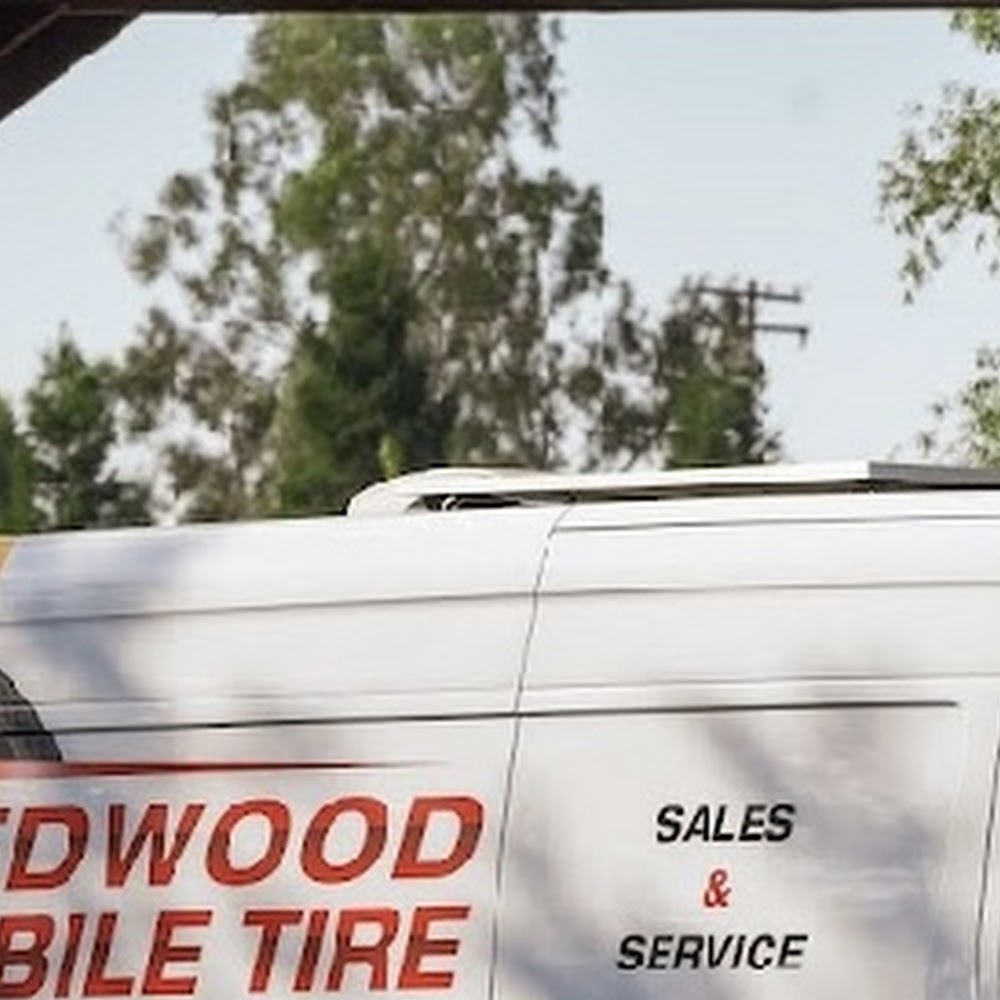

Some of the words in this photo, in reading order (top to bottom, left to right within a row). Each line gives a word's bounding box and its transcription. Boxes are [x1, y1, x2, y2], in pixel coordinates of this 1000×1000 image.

[656, 803, 797, 842] SALES
[0, 796, 485, 890] DWOOD
[703, 869, 732, 908] &
[243, 906, 471, 994] TIRE
[617, 933, 809, 971] SERVICE
